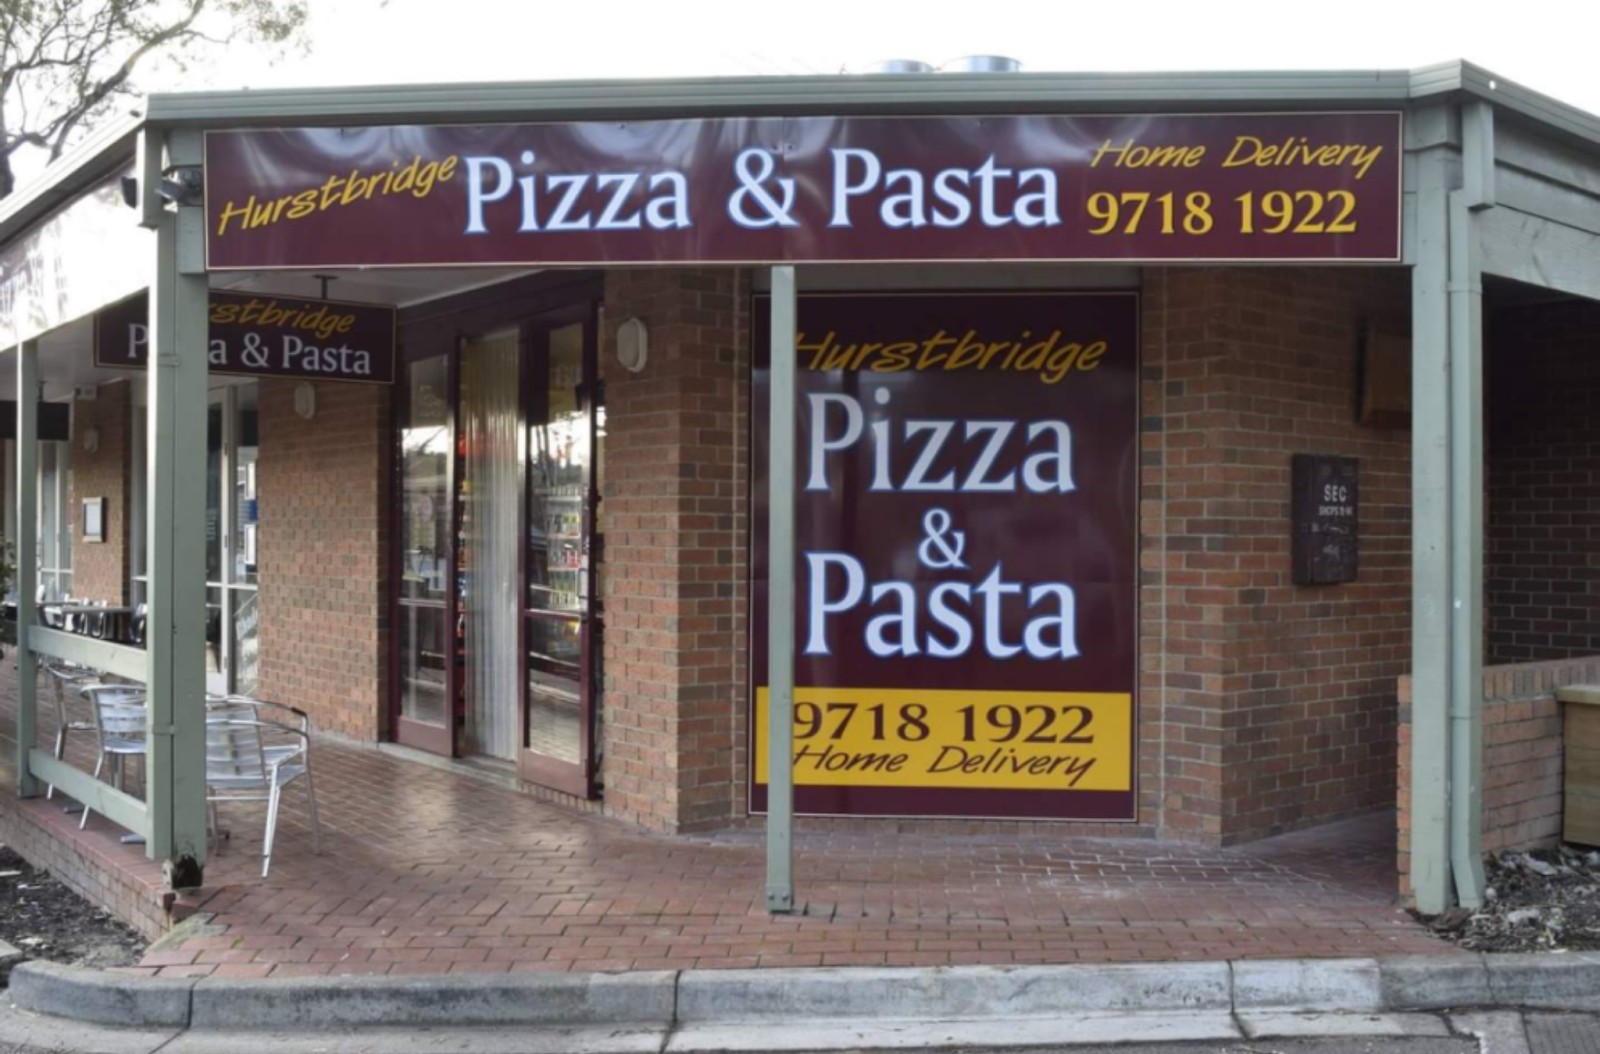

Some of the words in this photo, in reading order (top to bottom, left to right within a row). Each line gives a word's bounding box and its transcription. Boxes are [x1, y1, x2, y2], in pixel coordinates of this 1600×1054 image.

[1090, 138, 1206, 169] Home
[1222, 136, 1383, 180] Delivery
[218, 154, 457, 236] Hurstbridge
[464, 150, 693, 235] Pizza
[728, 148, 799, 228] &
[827, 147, 1061, 228] Pasta
[1087, 191, 1214, 236] 9718
[1236, 190, 1358, 234] 1922
[208, 298, 356, 338] stbridge
[241, 332, 269, 368] &
[282, 334, 371, 375] Pasta
[795, 329, 1107, 384] Hurstbridge
[805, 386, 1077, 494] Pizza
[1324, 484, 1347, 502] SEC
[917, 507, 967, 569] &
[804, 551, 1080, 660] Pasta
[793, 702, 931, 742] 9718
[955, 705, 1095, 744] 1922
[793, 745, 909, 773] Home
[926, 745, 1097, 788] Delivery
